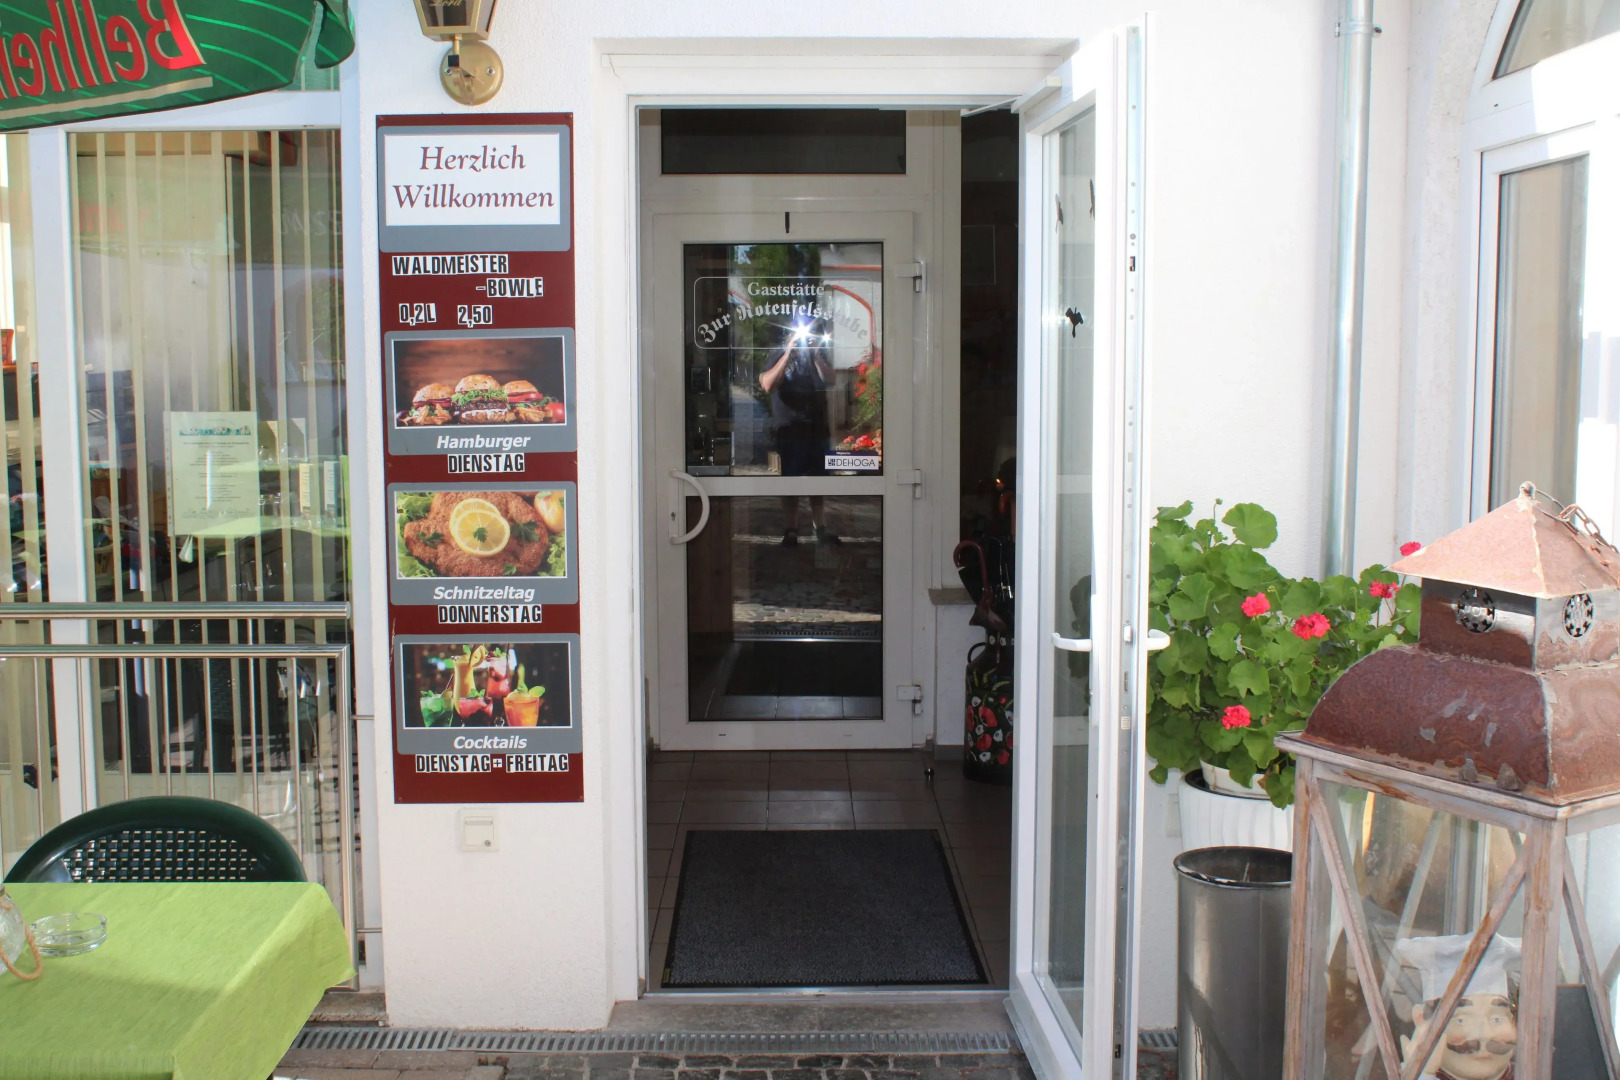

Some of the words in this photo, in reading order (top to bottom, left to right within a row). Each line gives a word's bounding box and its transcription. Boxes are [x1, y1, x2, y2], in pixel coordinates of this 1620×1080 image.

[419, 145, 526, 172] Herzlich
[392, 184, 555, 208] Willkommen
[393, 255, 508, 275] WALDMEISTER
[747, 282, 825, 296] Gaststätte
[399, 304, 436, 325] 0,2L
[458, 305, 492, 327] 2,50
[697, 313, 731, 344] Zur
[736, 299, 868, 340] Rotenfelssube
[436, 435, 531, 450] Hamburger
[448, 454, 525, 473] DIENSTAG
[836, 458, 876, 467] DEHOGA
[433, 586, 535, 602] Schnitzeltag
[439, 605, 542, 624] DONNERSTAG
[453, 735, 528, 749] Cocktails
[416, 754, 491, 773] DIENSTAG
[506, 754, 569, 773] FREITAG
